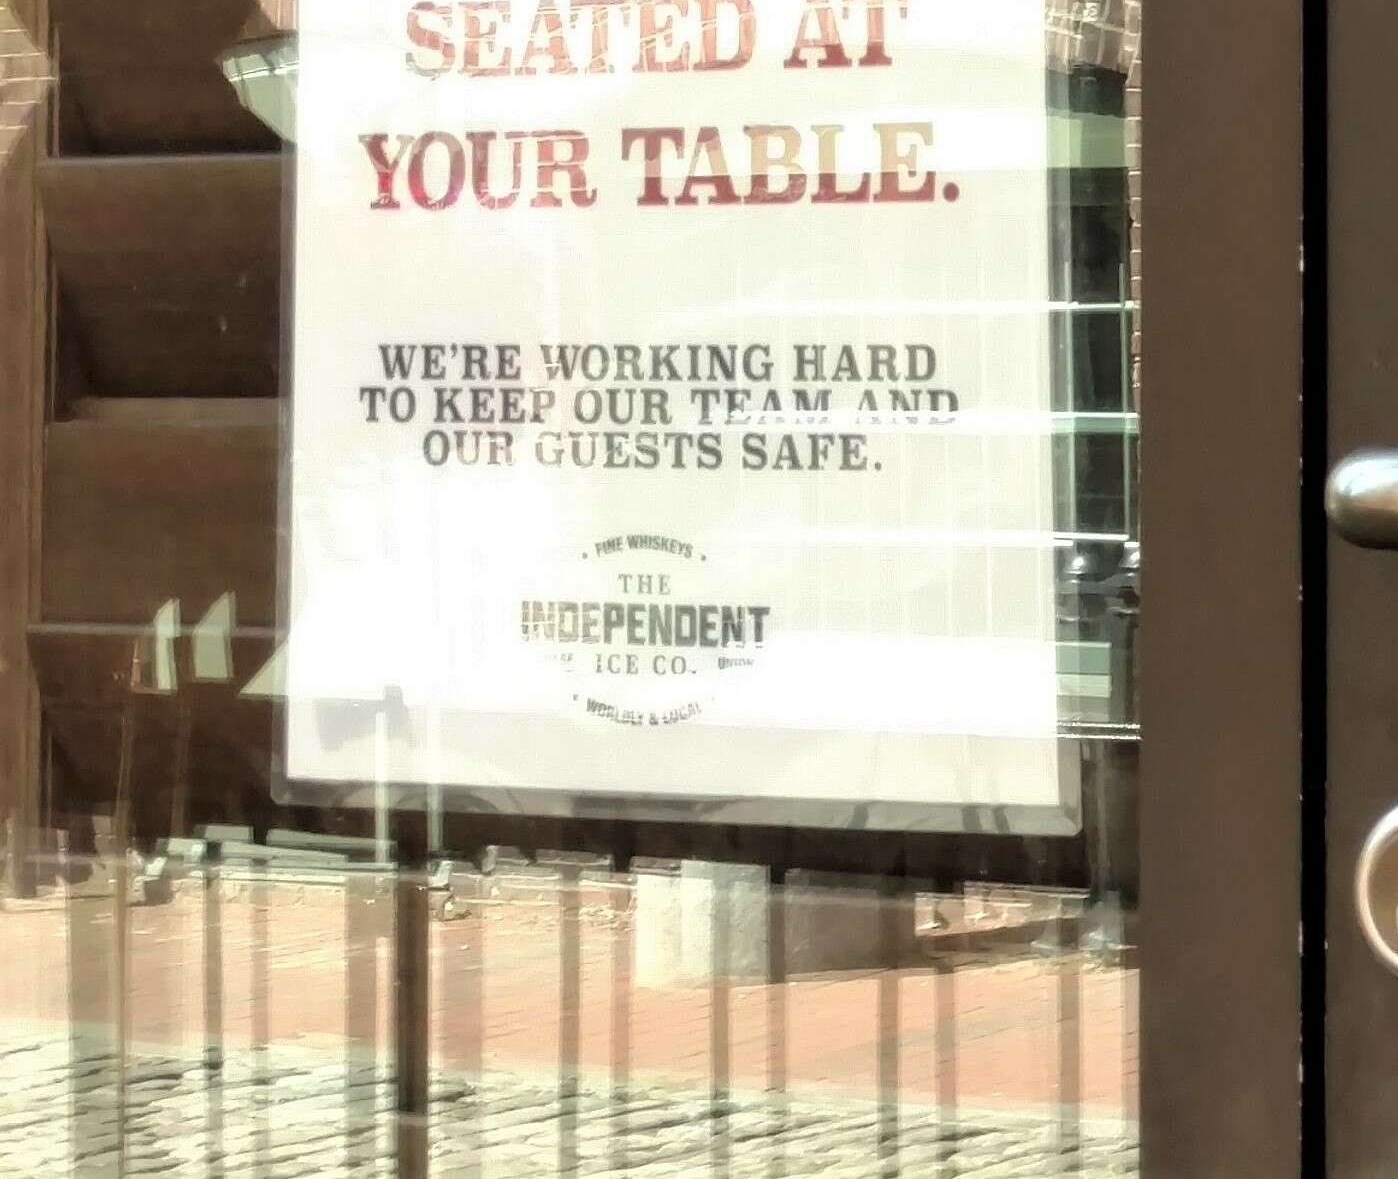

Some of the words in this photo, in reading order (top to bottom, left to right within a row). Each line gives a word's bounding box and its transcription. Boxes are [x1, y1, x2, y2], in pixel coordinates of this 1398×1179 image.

[357, 128, 600, 212] YOUR
[620, 121, 961, 210] TABLE.
[378, 343, 521, 382] WE'RE
[539, 343, 774, 383] WORKING
[792, 343, 938, 383] HARD
[359, 387, 418, 423] TO
[432, 386, 557, 424] KEEP
[573, 388, 672, 425] OUR
[690, 387, 832, 425] TEAM
[856, 388, 959, 425] AND
[422, 430, 516, 467] OUR
[534, 431, 724, 471] GUESTS
[740, 432, 883, 472] SAFE.
[594, 535, 624, 558] FINE
[626, 534, 694, 559] WHISKEYS
[617, 573, 672, 596] THE
[520, 600, 771, 649] INDEPENDENT
[595, 653, 639, 675] ICE
[652, 654, 698, 676] CO.
